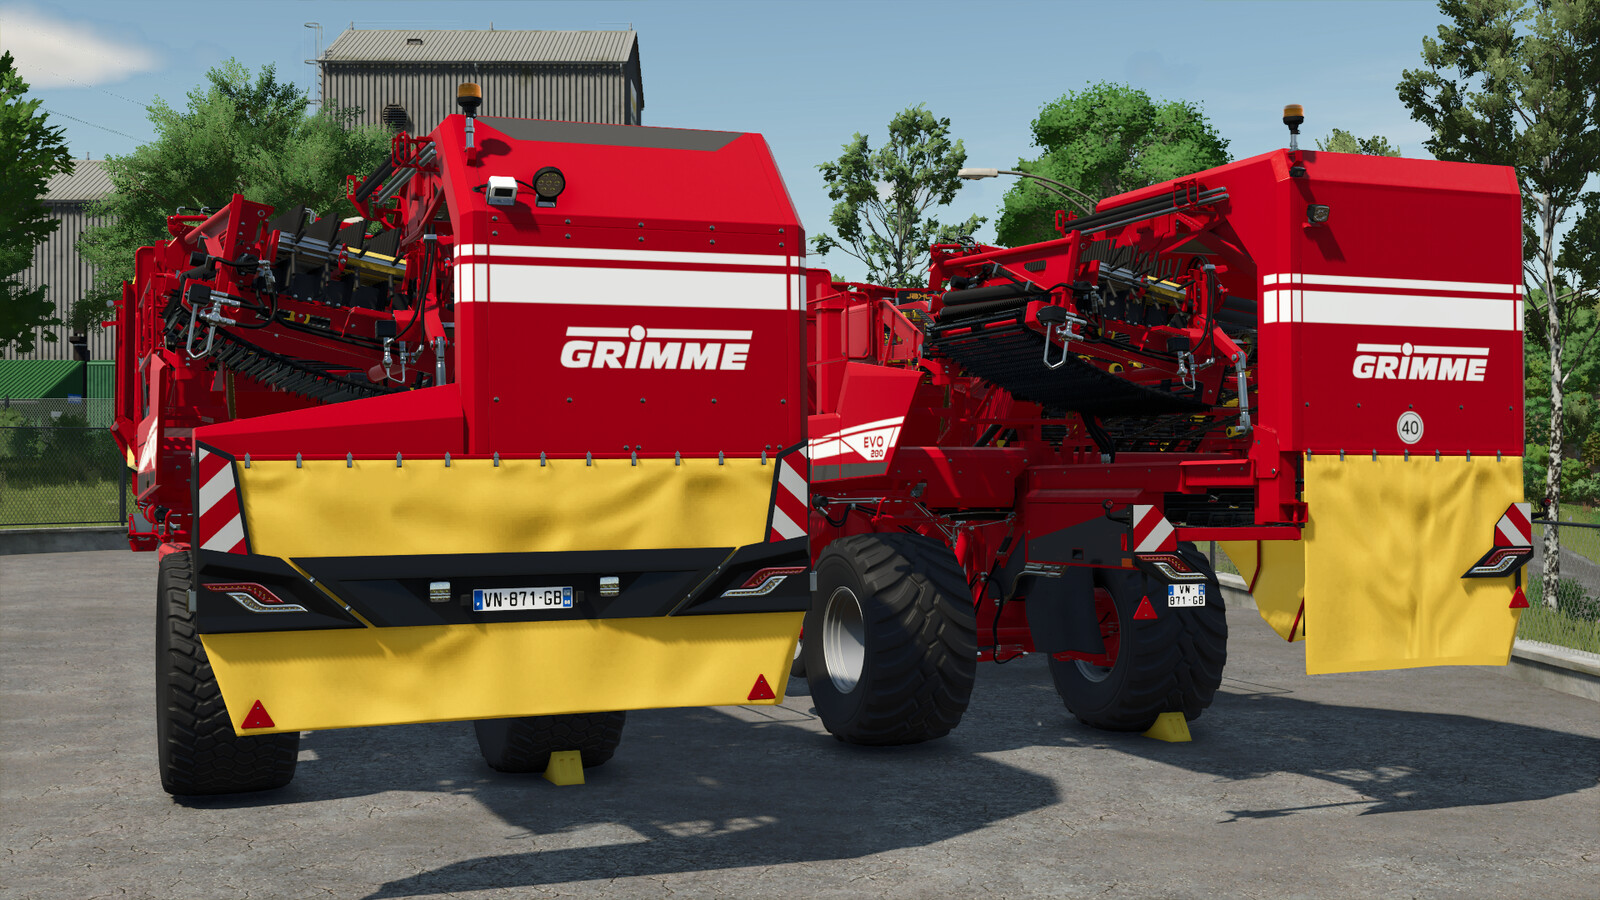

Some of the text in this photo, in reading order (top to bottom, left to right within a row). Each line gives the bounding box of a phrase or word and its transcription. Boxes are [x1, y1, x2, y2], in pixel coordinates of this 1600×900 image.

[560, 325, 752, 371] GRIMME
[1352, 342, 1488, 382] GRIMME
[1401, 420, 1419, 435] 40
[864, 435, 884, 448] EVO
[484, 590, 562, 608] VN-871-GB
[1169, 595, 1204, 606] 871-GB
